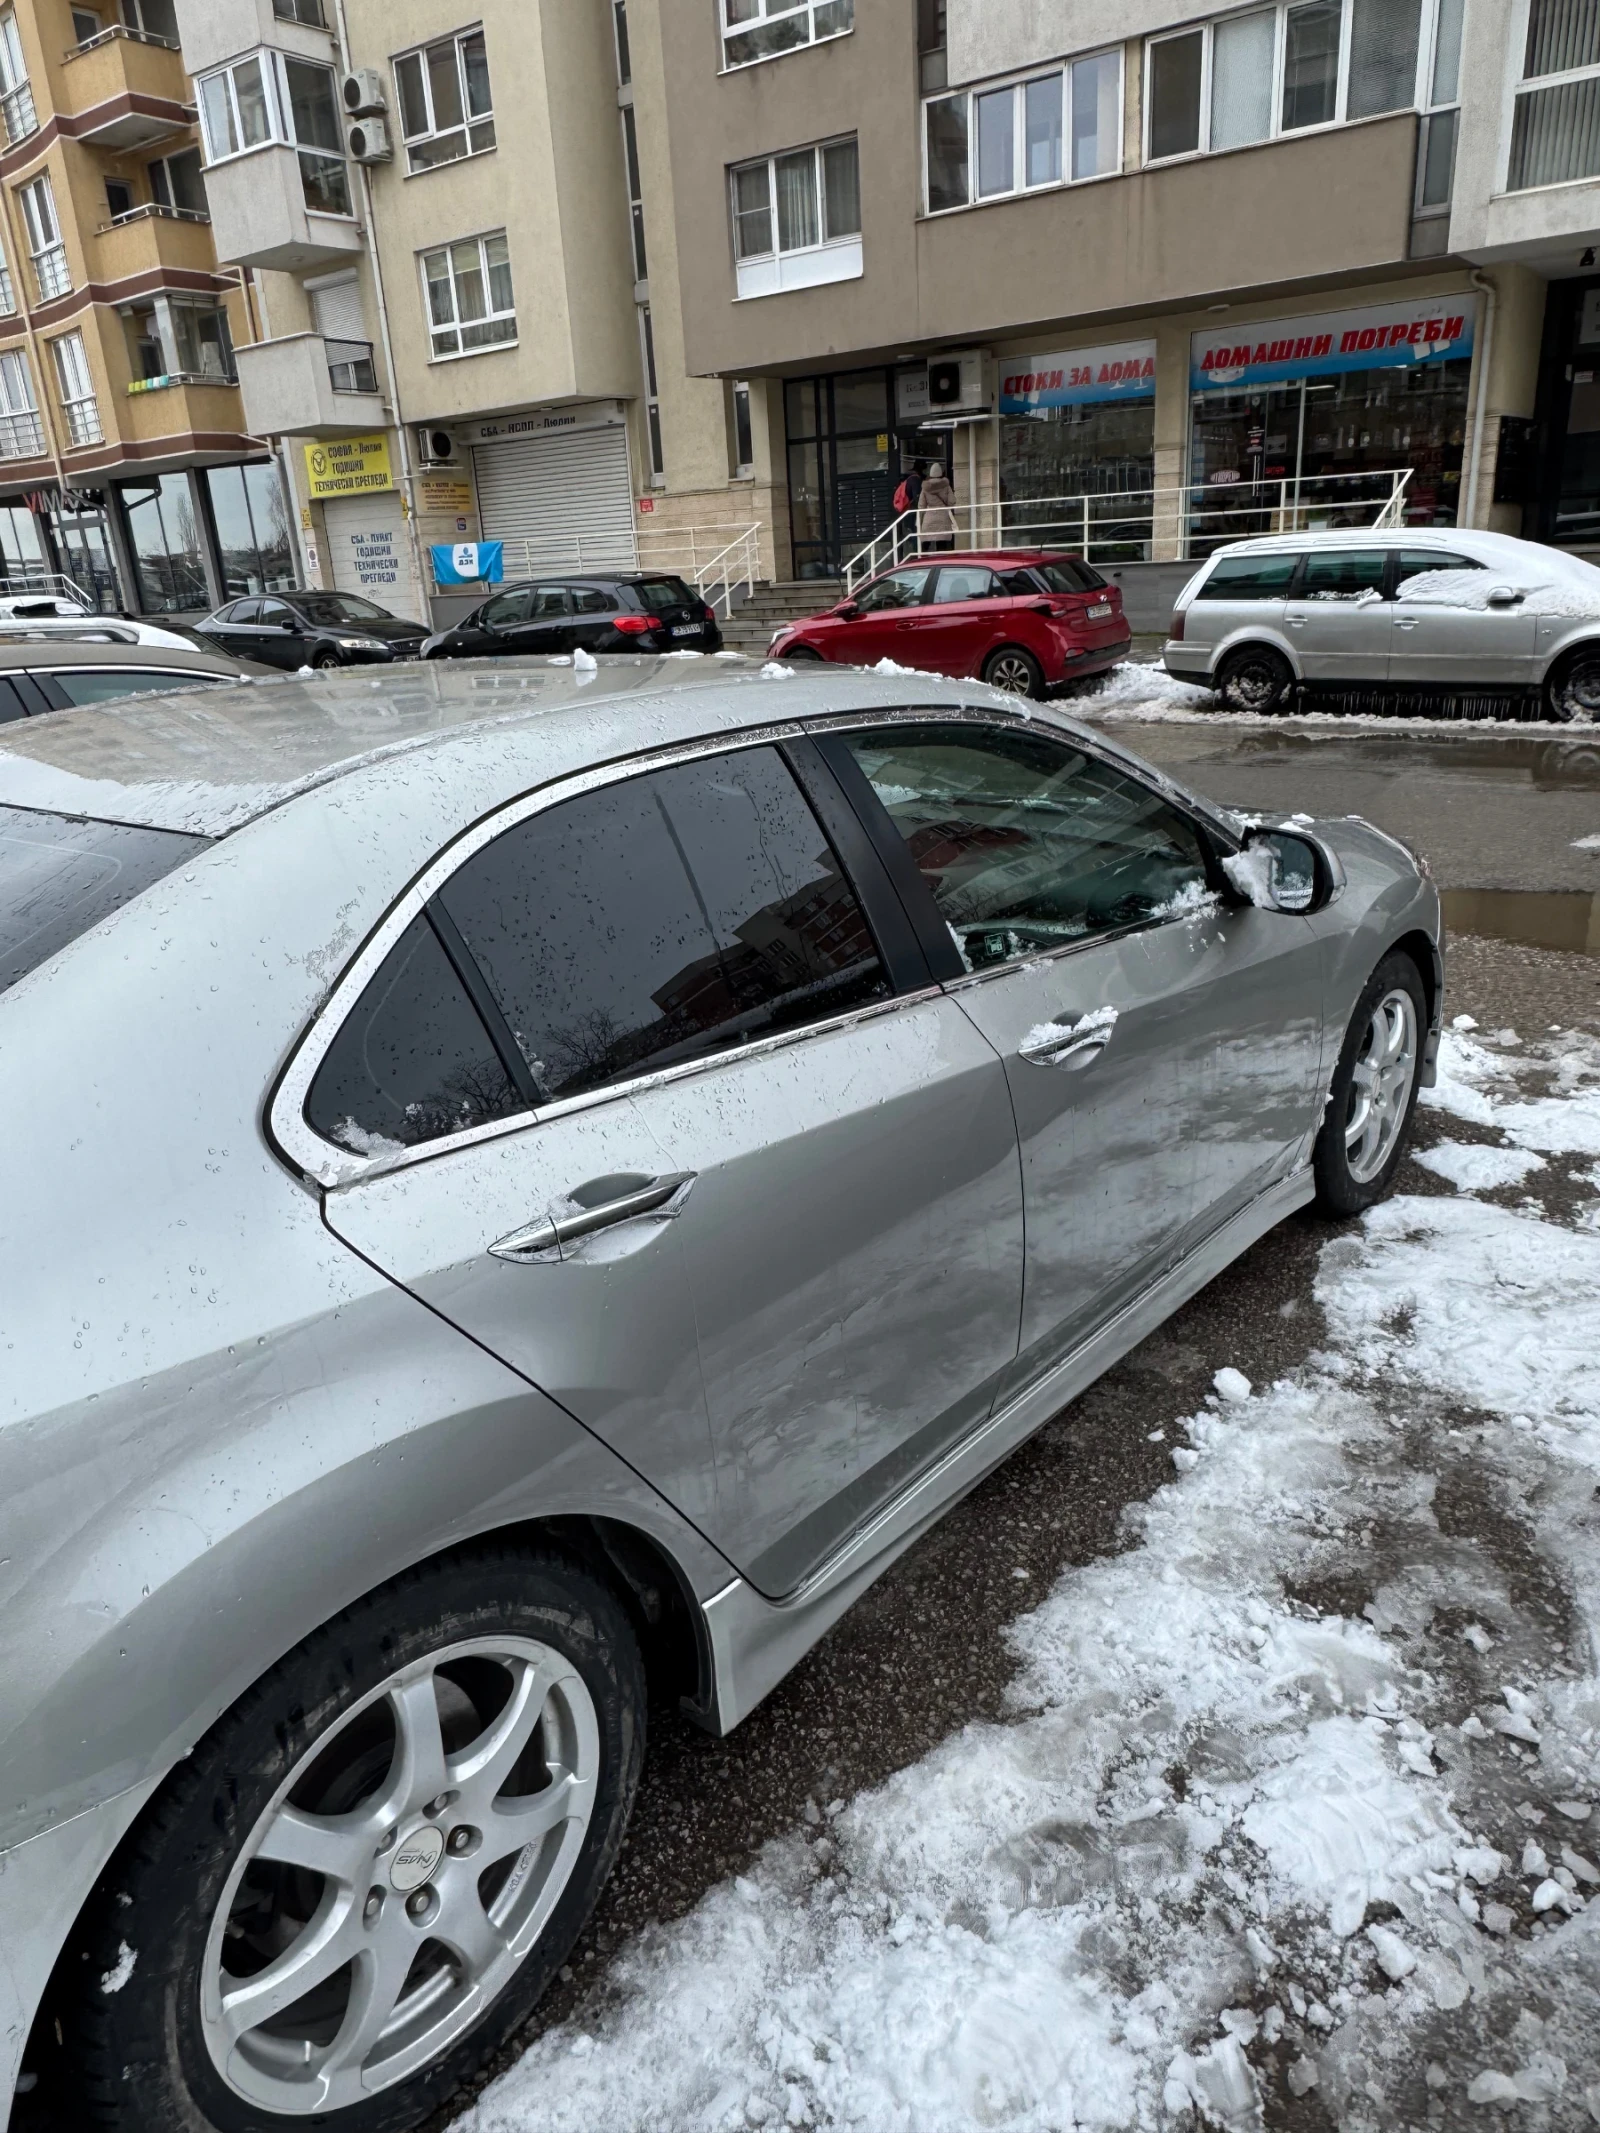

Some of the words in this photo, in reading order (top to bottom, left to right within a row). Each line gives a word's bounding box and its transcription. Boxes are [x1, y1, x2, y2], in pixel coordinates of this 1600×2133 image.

[1201, 334, 1333, 371] ДОМАШНИ
[1339, 315, 1465, 353] ПОТРЕБИ
[1003, 369, 1064, 395] СТОКИ
[1068, 366, 1092, 387] ЗА
[1097, 357, 1155, 384] ДОМА
[480, 426, 499, 437] СБА
[543, 416, 576, 428] Люлин
[328, 444, 353, 459] СОФИЯ
[332, 459, 364, 475] ГОДИШНИ
[314, 477, 354, 492] ТЕХНИЧЕСКИ
[354, 472, 389, 487] ПРЕГЛЕДИ
[350, 534, 365, 544] СБА
[370, 532, 392, 543] ПУНКТ
[356, 545, 391, 559] ГОДИШНИ
[354, 558, 398, 571] ТЕХНИЧЕСКИ
[360, 571, 396, 583] ПРЕГЛЕДИ
